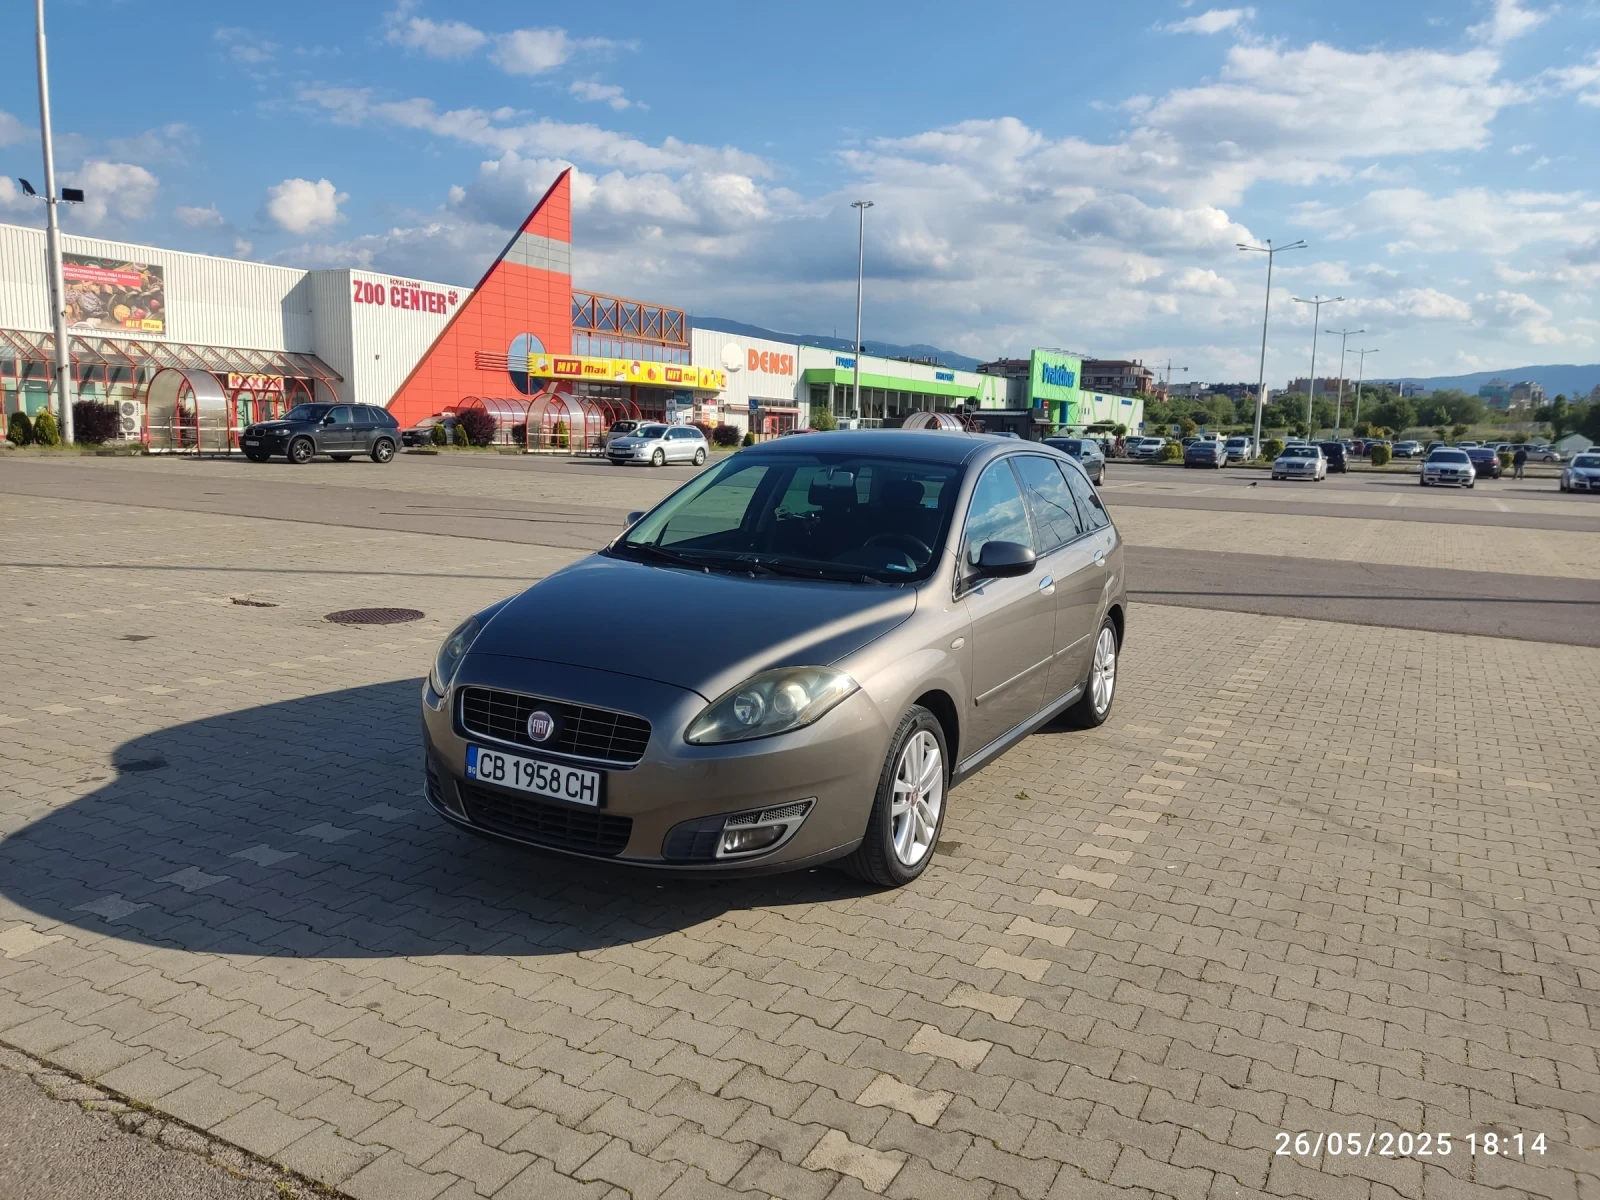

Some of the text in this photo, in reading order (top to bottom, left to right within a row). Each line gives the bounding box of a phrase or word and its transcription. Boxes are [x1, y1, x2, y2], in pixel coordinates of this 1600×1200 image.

[353, 280, 447, 315] ZOO CENTER
[126, 319, 141, 328] HIT
[556, 361, 607, 375] HIT Max
[748, 348, 794, 377] DENSI
[667, 370, 697, 382] HIT Max
[1042, 361, 1076, 389] Praktiker
[532, 719, 549, 735] FIAT
[467, 765, 476, 775] BG
[479, 752, 595, 802] CB 1958 CH
